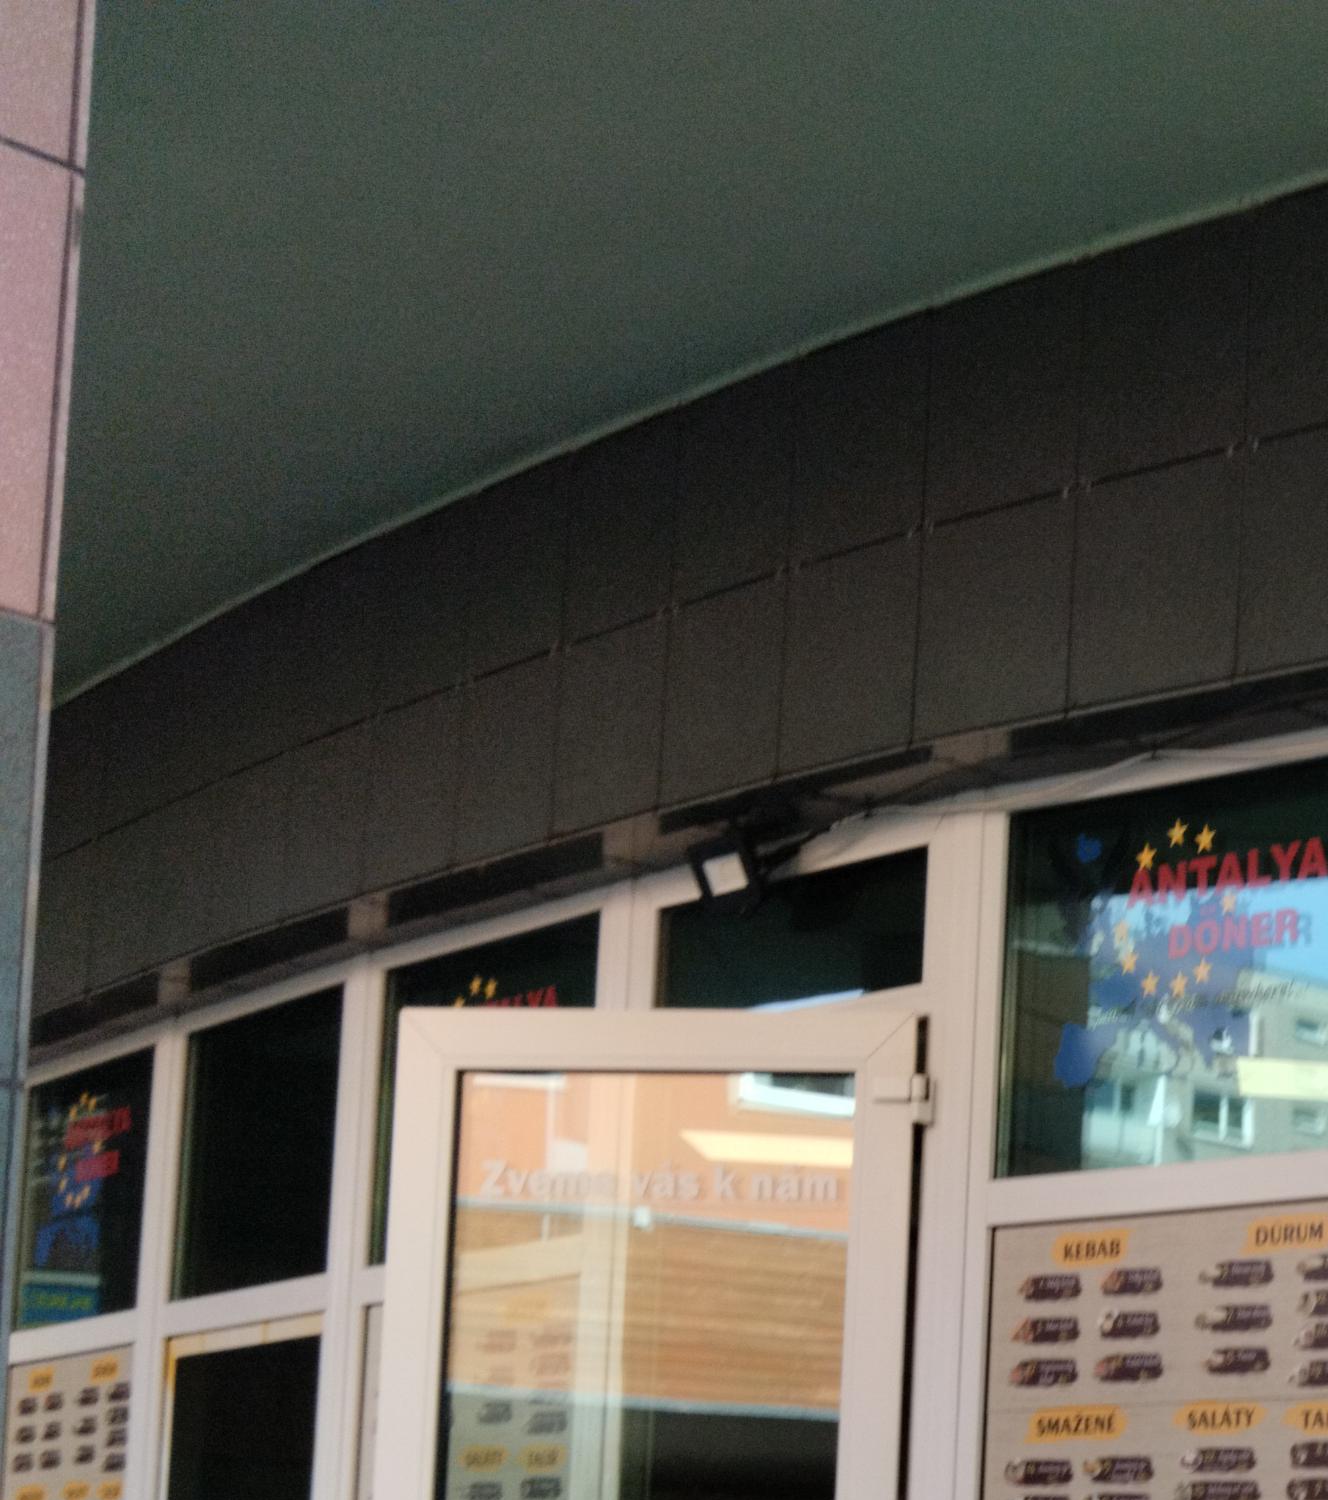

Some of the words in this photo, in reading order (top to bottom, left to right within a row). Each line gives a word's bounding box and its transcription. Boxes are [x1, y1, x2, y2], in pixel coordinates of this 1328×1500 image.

[1169, 905, 1300, 960] DÖNER
[633, 1159, 701, 1199] vás
[714, 1165, 738, 1198] k
[752, 1164, 840, 1200] nám
[1063, 1237, 1121, 1261] KEBAB
[1036, 1409, 1118, 1438] SMAŽENÉ
[1187, 1403, 1256, 1431] SALÁTY
